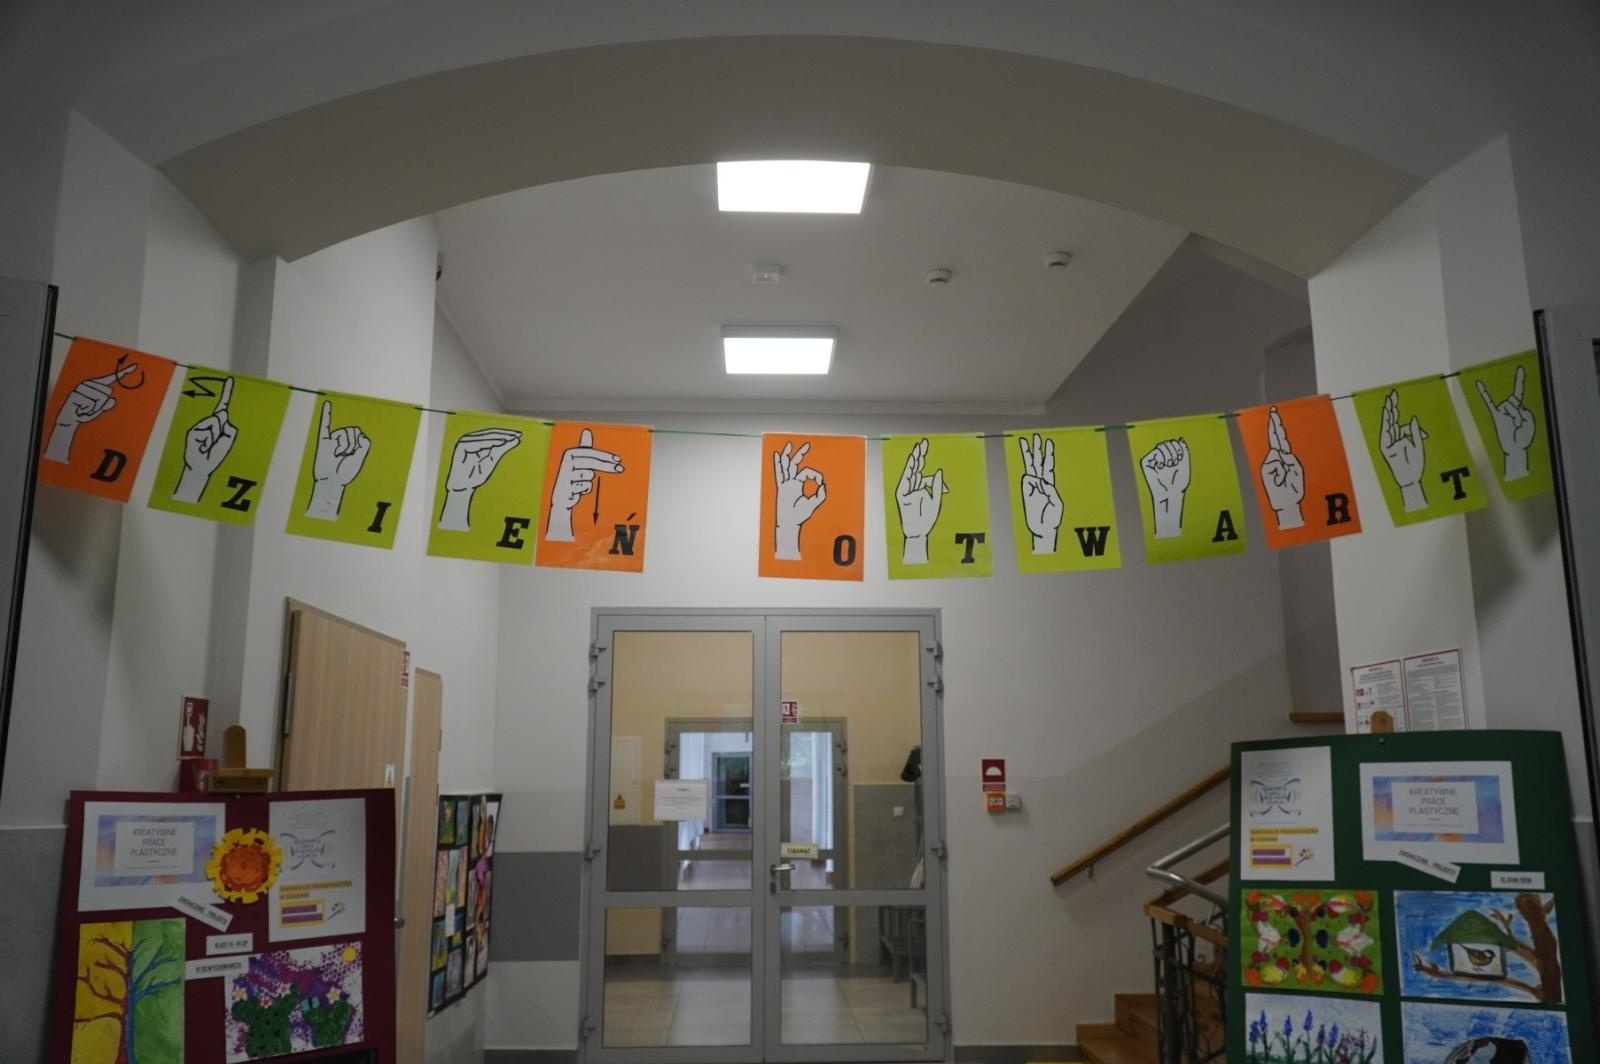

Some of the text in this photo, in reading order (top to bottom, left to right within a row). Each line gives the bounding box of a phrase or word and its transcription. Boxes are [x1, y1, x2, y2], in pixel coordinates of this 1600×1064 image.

[1408, 787, 1457, 797] KREATYWNE
[1421, 797, 1446, 806] PRACE
[1408, 806, 1460, 817] PLASTYCZNE
[132, 828, 178, 838] KREATYWNE
[142, 838, 166, 848] PRACE
[129, 847, 178, 858] PLASTYCZNE
